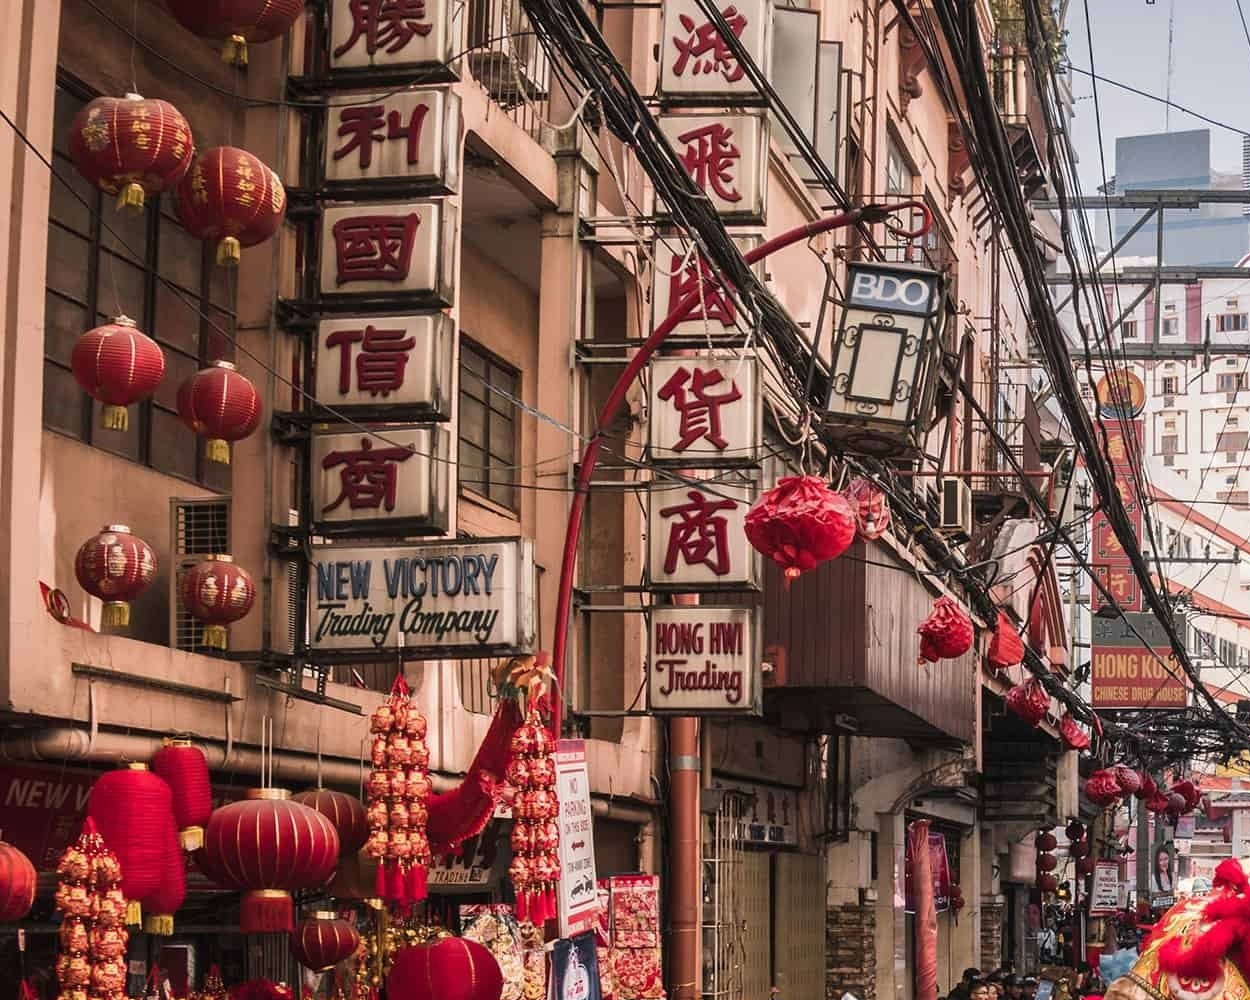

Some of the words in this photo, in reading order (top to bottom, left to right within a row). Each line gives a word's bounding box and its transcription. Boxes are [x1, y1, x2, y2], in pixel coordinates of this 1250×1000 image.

[851, 272, 930, 306] BDO
[316, 560, 372, 601] NEW
[384, 554, 499, 599] VICTORY
[315, 602, 395, 646] Trading
[399, 598, 499, 643] Company
[655, 622, 703, 656] HONG
[709, 622, 743, 656] HWI
[655, 659, 744, 704] Trading
[1094, 653, 1138, 679] HONG
[1094, 685, 1129, 701] CHINESE
[1157, 687, 1185, 703] HOUSE
[5, 777, 71, 810] NEW
